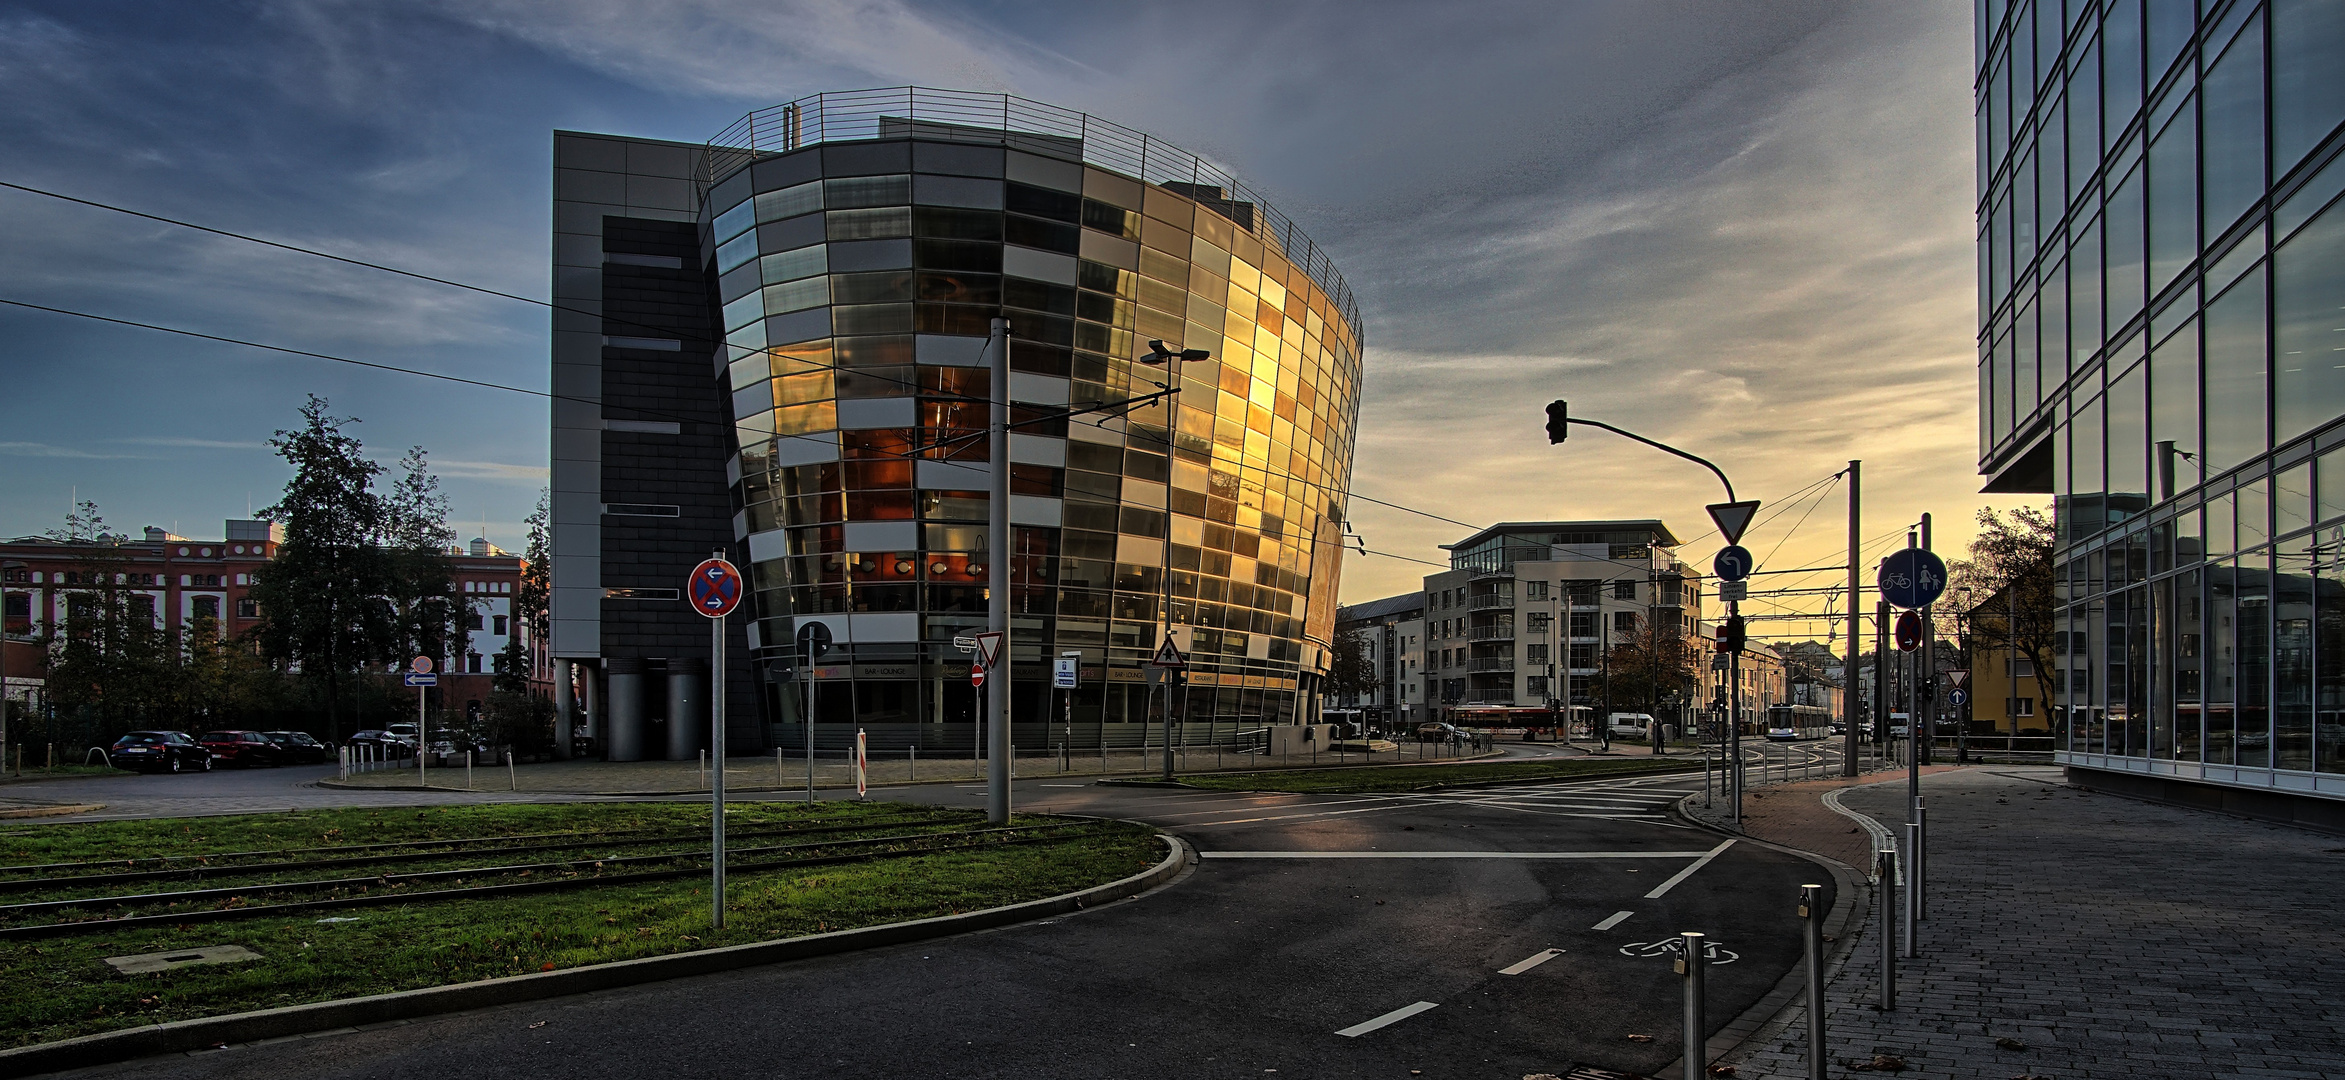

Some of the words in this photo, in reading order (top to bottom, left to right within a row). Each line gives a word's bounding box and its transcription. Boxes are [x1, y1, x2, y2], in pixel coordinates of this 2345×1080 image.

[880, 667, 906, 675] LOUNGE
[1081, 668, 1094, 677] art's
[1126, 671, 1144, 679] LOUNGE
